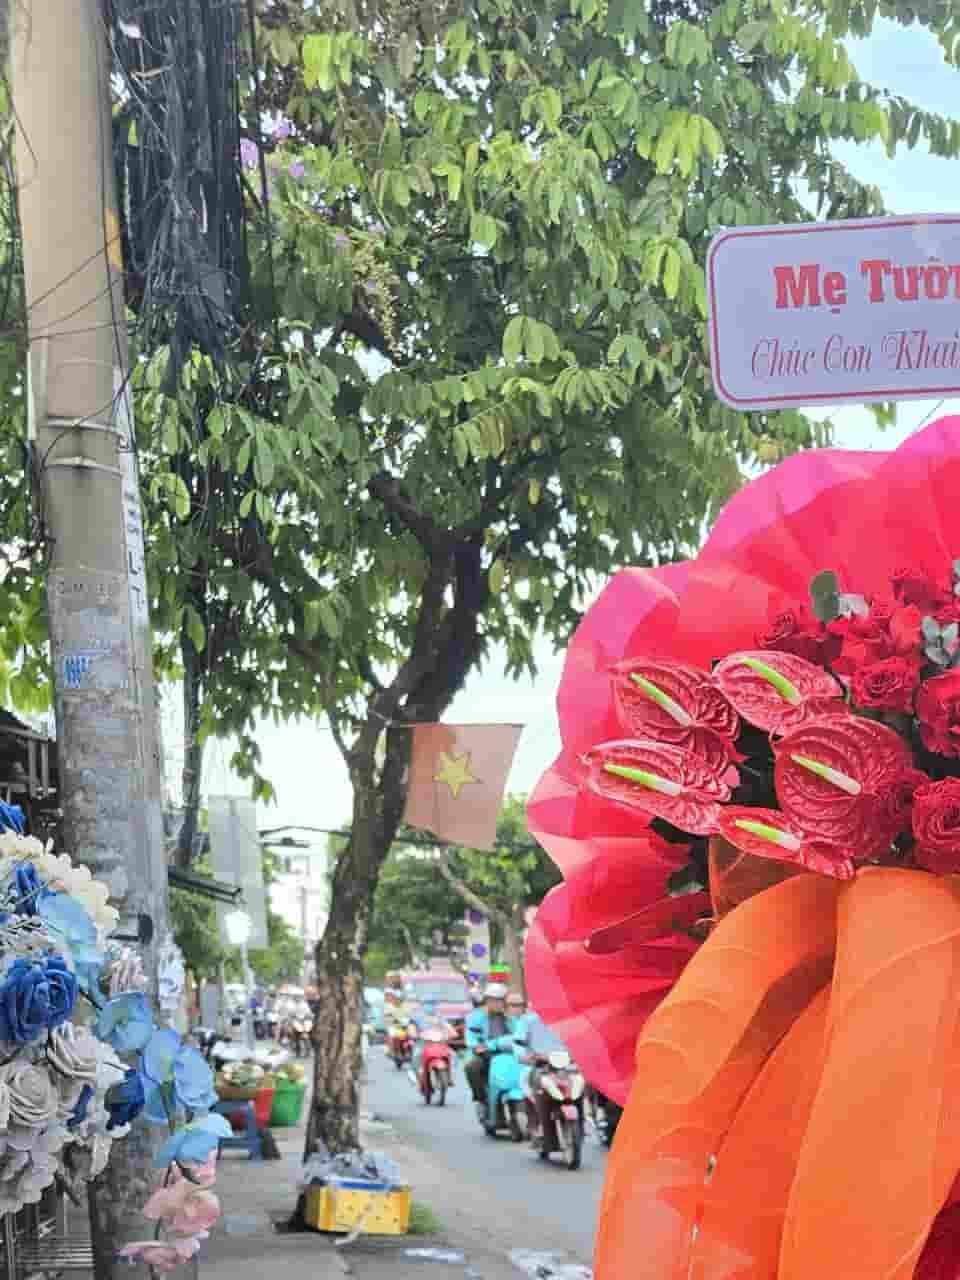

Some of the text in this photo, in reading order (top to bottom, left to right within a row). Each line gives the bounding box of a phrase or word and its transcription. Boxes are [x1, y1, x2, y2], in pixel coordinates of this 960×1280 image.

[773, 263, 848, 314] Mẹ
[751, 337, 816, 378] Chúc
[822, 332, 872, 376] Con
[880, 327, 960, 375] Khai
